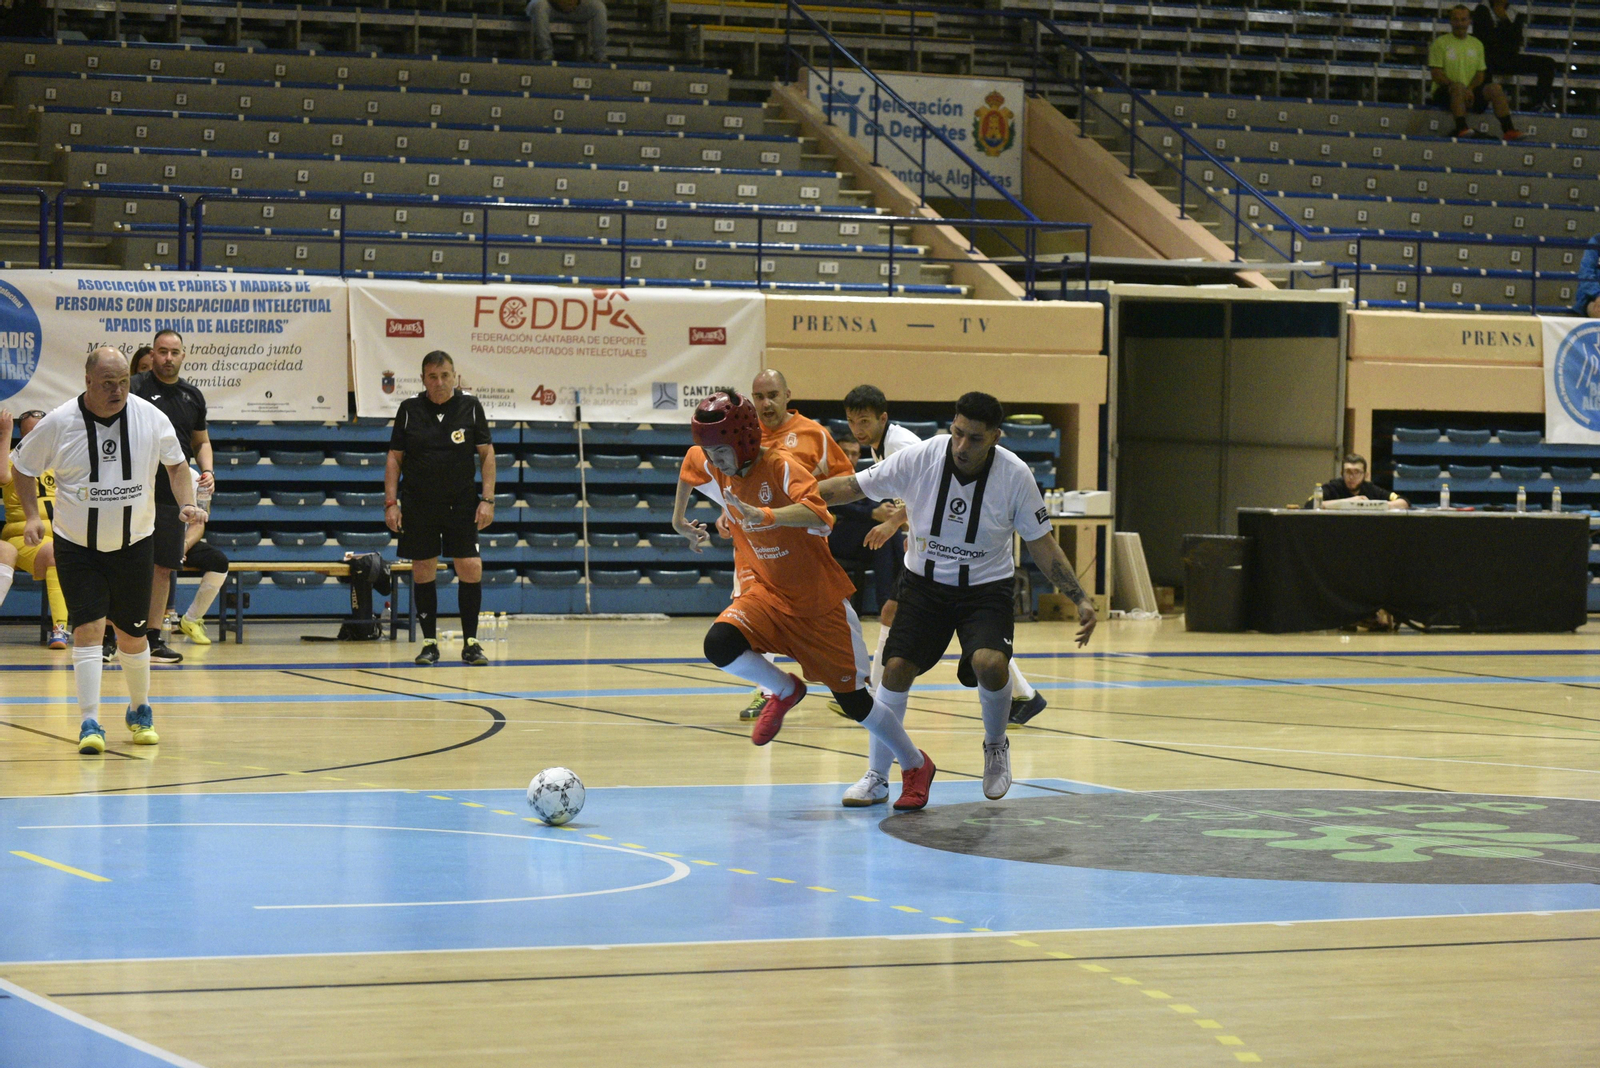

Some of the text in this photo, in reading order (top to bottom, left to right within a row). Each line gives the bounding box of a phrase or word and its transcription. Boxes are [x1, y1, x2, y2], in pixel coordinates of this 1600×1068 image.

[890, 120, 966, 142] Depotes
[78, 279, 311, 293] ASOCIACIÓN DE PADRES Y MADRES DE
[55, 296, 331, 313] PERSONAS CON DISCAPACIDAD INTELECTUAL
[155, 316, 194, 333] BAHÍA
[197, 319, 212, 333] DE
[792, 315, 877, 332] PRENSA
[471, 332, 647, 346] FEDERACIÓN CÁNTABRA DE DEPORTE
[1461, 330, 1535, 347] PRENSA
[190, 343, 264, 357] trabajando
[267, 343, 302, 357] junto
[471, 344, 647, 358] PARA DISCAPACITADOS INTELECTUALES
[184, 360, 304, 373] con discapacidad
